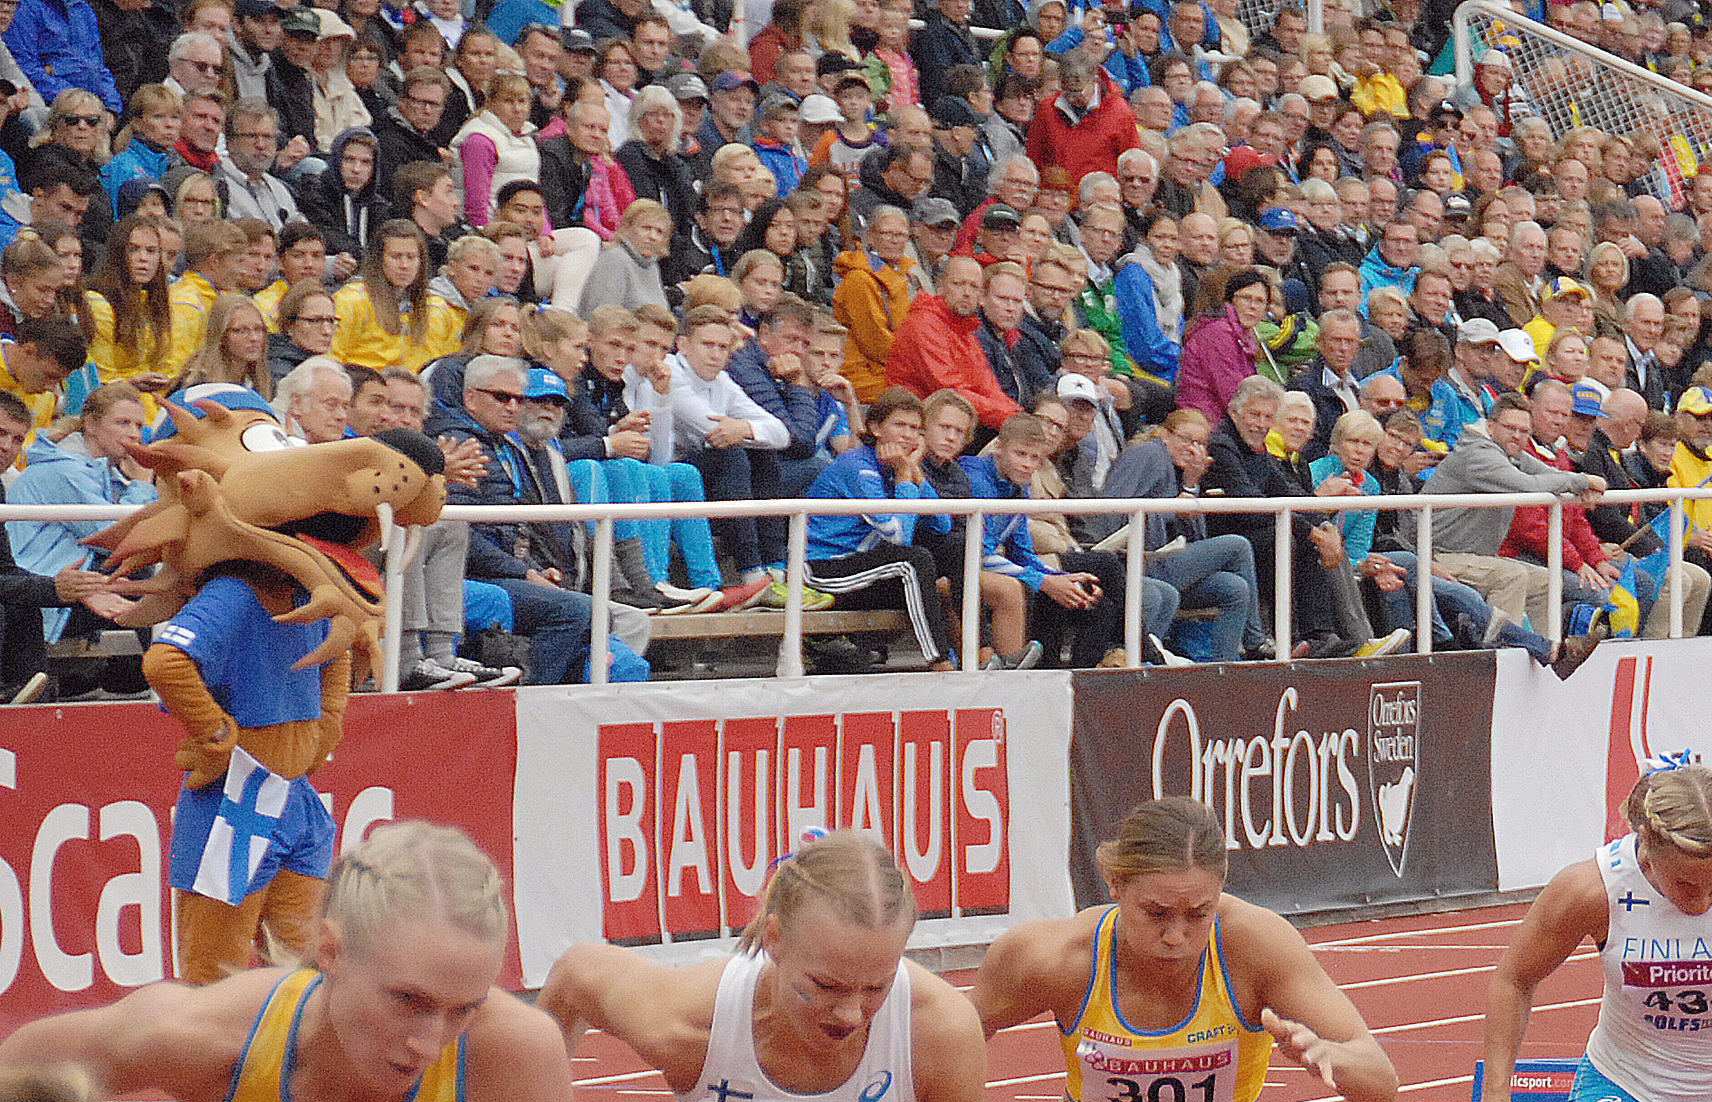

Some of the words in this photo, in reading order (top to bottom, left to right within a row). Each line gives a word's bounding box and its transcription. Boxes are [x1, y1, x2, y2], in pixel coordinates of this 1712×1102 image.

[1373, 691, 1416, 728] Orrefors
[1373, 731, 1414, 762] Sweden
[1151, 686, 1360, 850] Orrefors
[604, 739, 1003, 902] BAUHAUS
[1083, 1027, 1133, 1047] BAUHAUS
[1187, 1026, 1225, 1044] CRAFT
[1108, 1051, 1231, 1074] BAUHAUS
